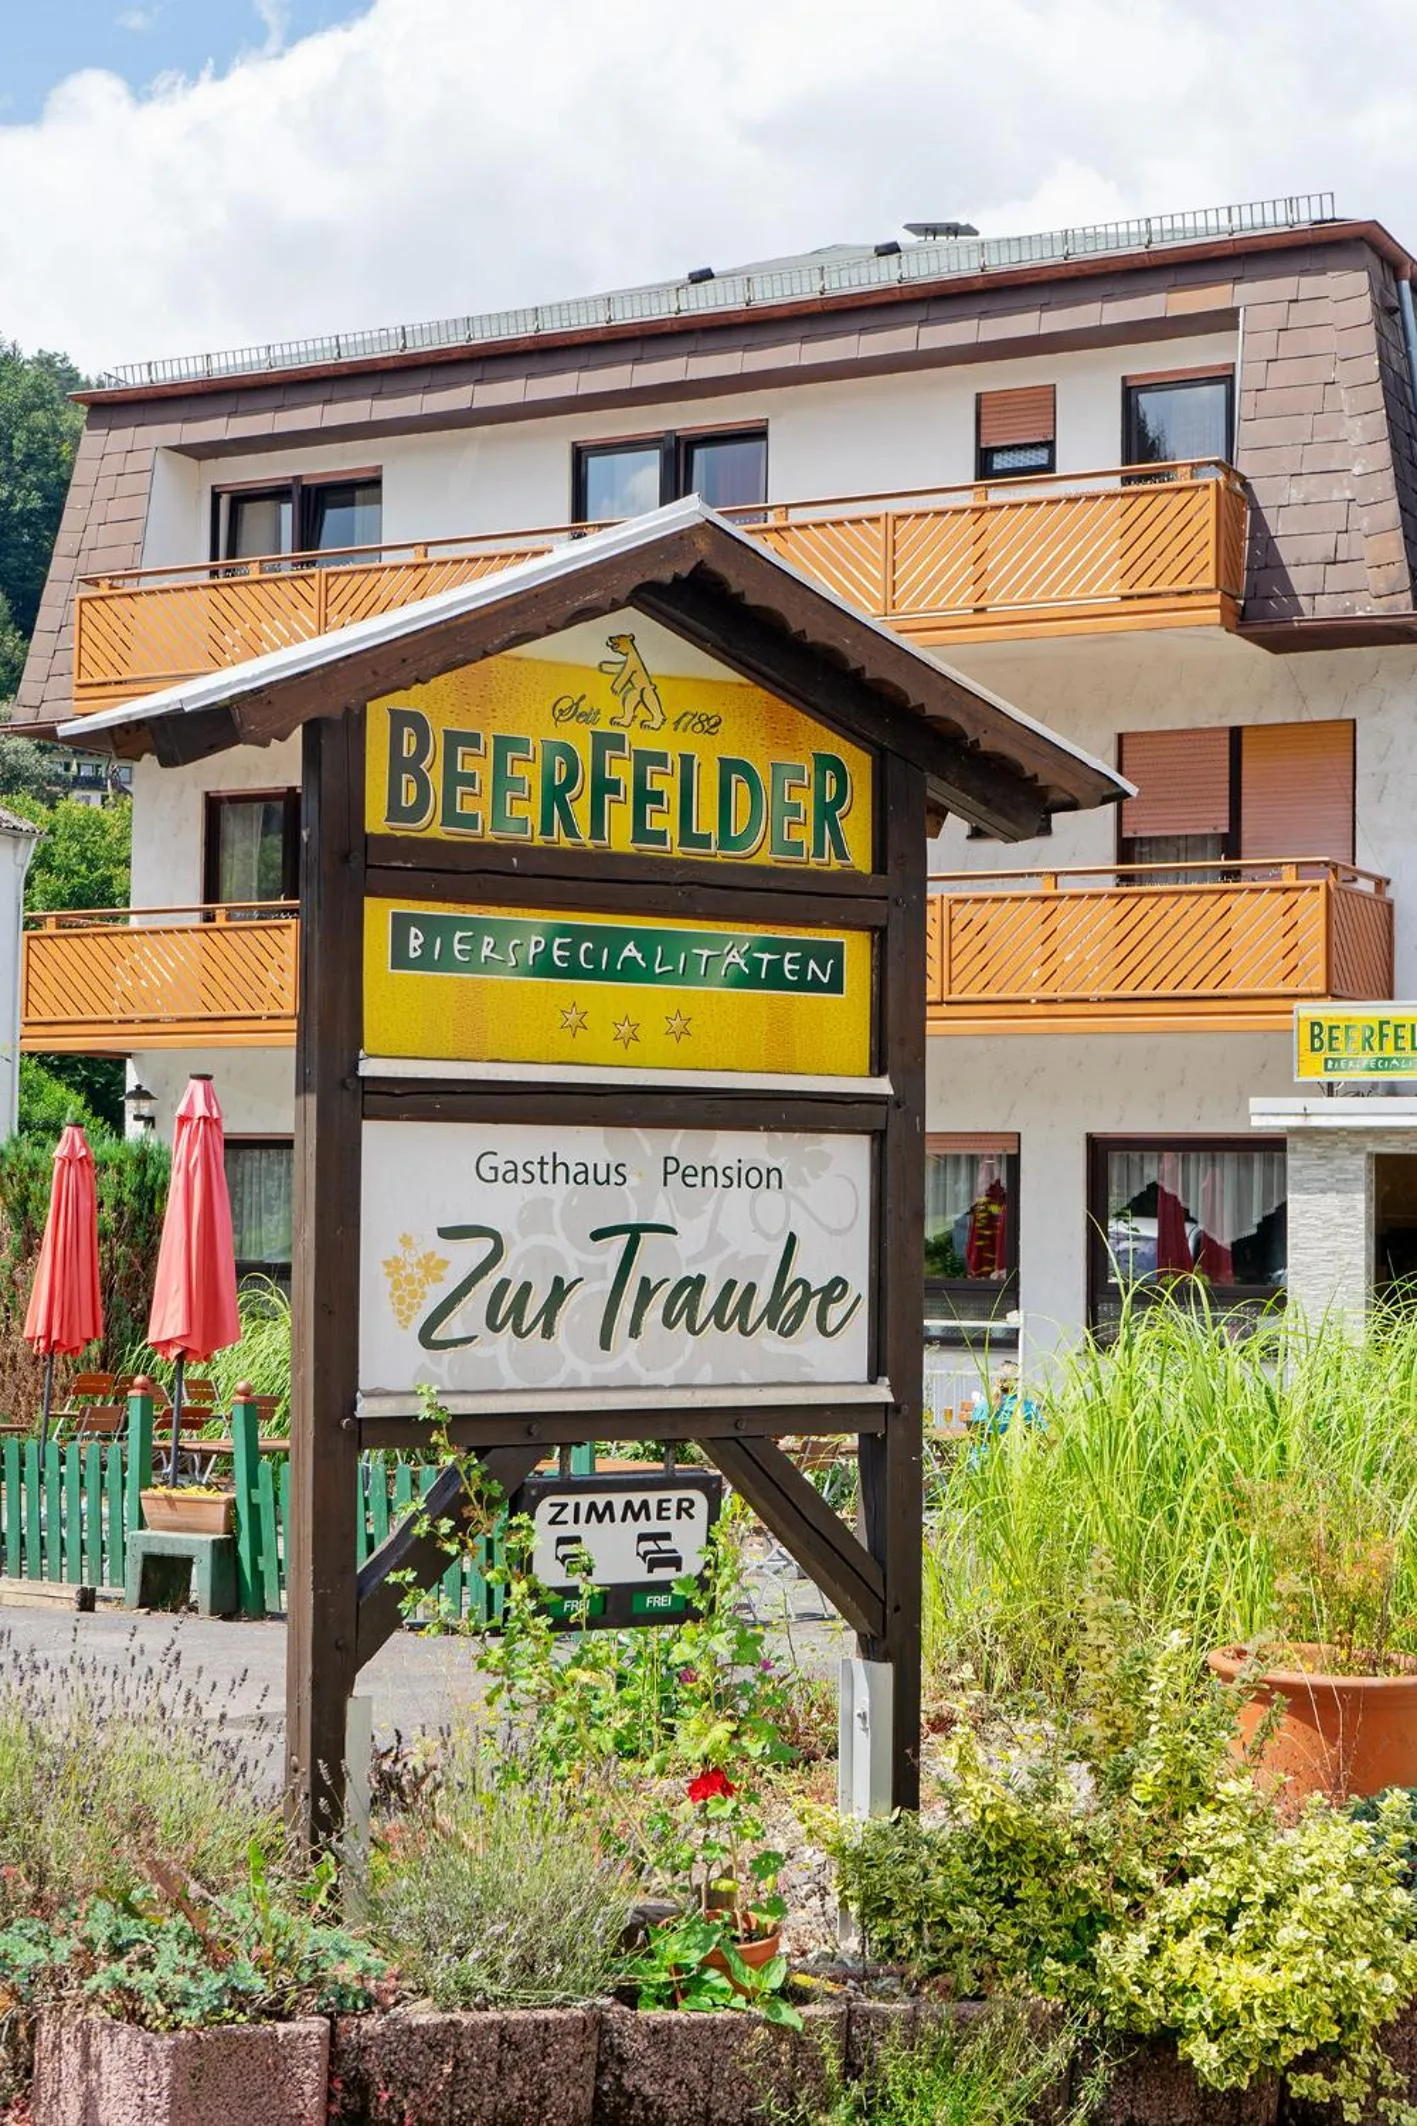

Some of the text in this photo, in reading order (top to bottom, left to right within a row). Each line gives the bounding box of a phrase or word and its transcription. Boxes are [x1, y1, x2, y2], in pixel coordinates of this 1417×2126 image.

[552, 694, 723, 736] Seit 1782
[384, 707, 854, 866] BEERFELDER
[408, 926, 836, 985] BIERSPECIALITÄTEN
[475, 1151, 784, 1190] Gasthaus Pension
[417, 1223, 863, 1353] Zur Traube
[547, 1497, 696, 1526] ZIMMER
[645, 1595, 672, 1607] FREI
